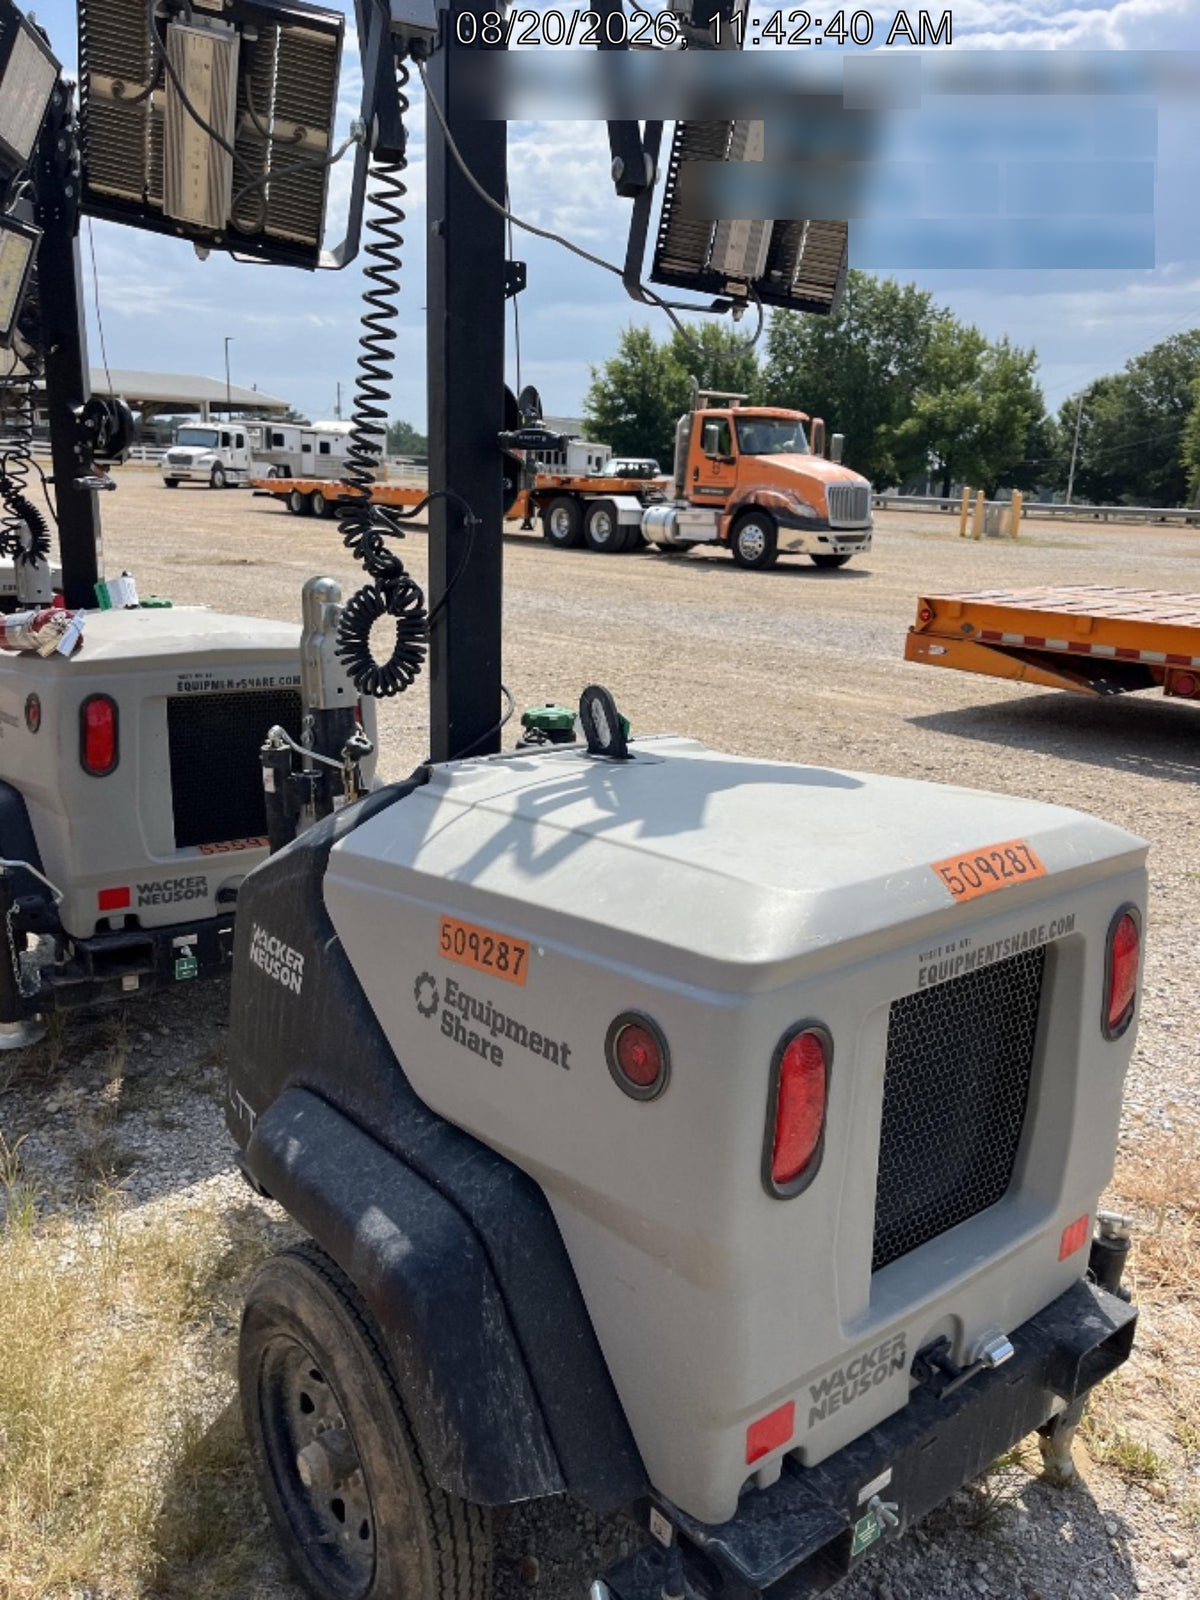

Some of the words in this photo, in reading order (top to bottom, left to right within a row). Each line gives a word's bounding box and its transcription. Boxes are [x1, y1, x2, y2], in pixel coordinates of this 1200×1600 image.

[136, 876, 208, 894] WACKER
[138, 886, 208, 907] NEUSON
[941, 845, 1037, 895] 509287
[249, 942, 303, 995] NEUSON
[440, 923, 526, 976] 509287
[918, 913, 1075, 988] EQUIPMENTSHARE.COM
[440, 1008, 504, 1067] Share
[443, 977, 572, 1071] Equipment
[808, 1331, 907, 1404] WACKER
[808, 1351, 906, 1429] NEUSON
